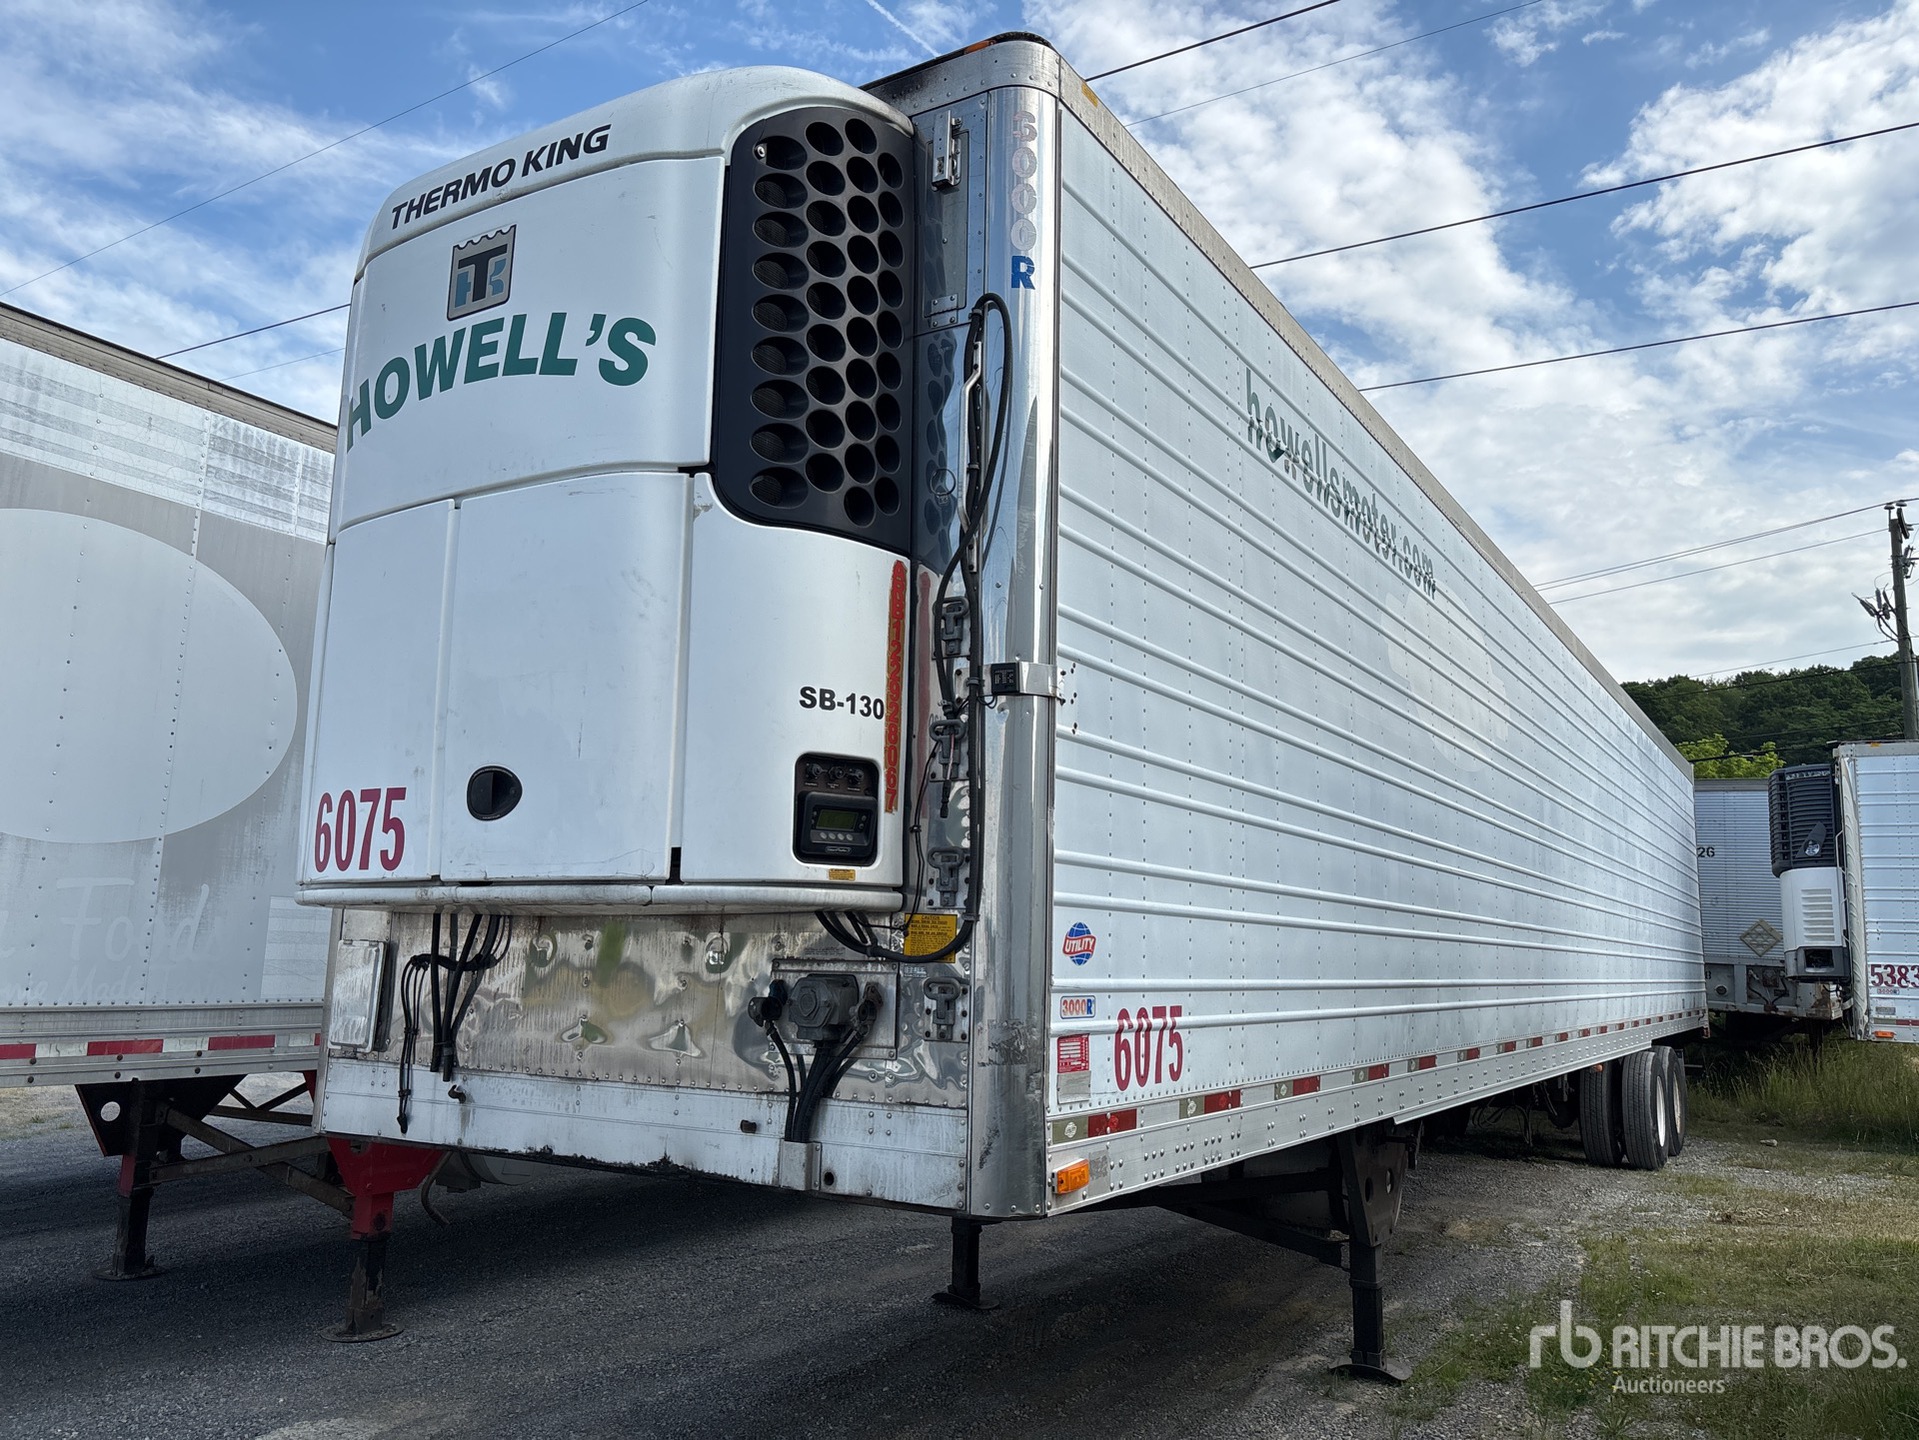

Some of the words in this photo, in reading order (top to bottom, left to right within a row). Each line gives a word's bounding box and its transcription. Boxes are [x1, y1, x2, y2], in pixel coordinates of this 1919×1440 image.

[392, 158, 516, 230] THERMO
[521, 124, 611, 177] KING
[347, 312, 657, 454] HOWELL'S
[799, 686, 884, 720] SB-130
[314, 787, 407, 873] 6075
[1064, 937, 1095, 953] UTILITY
[1062, 998, 1094, 1016] 3000R
[1114, 1005, 1184, 1092] 6075
